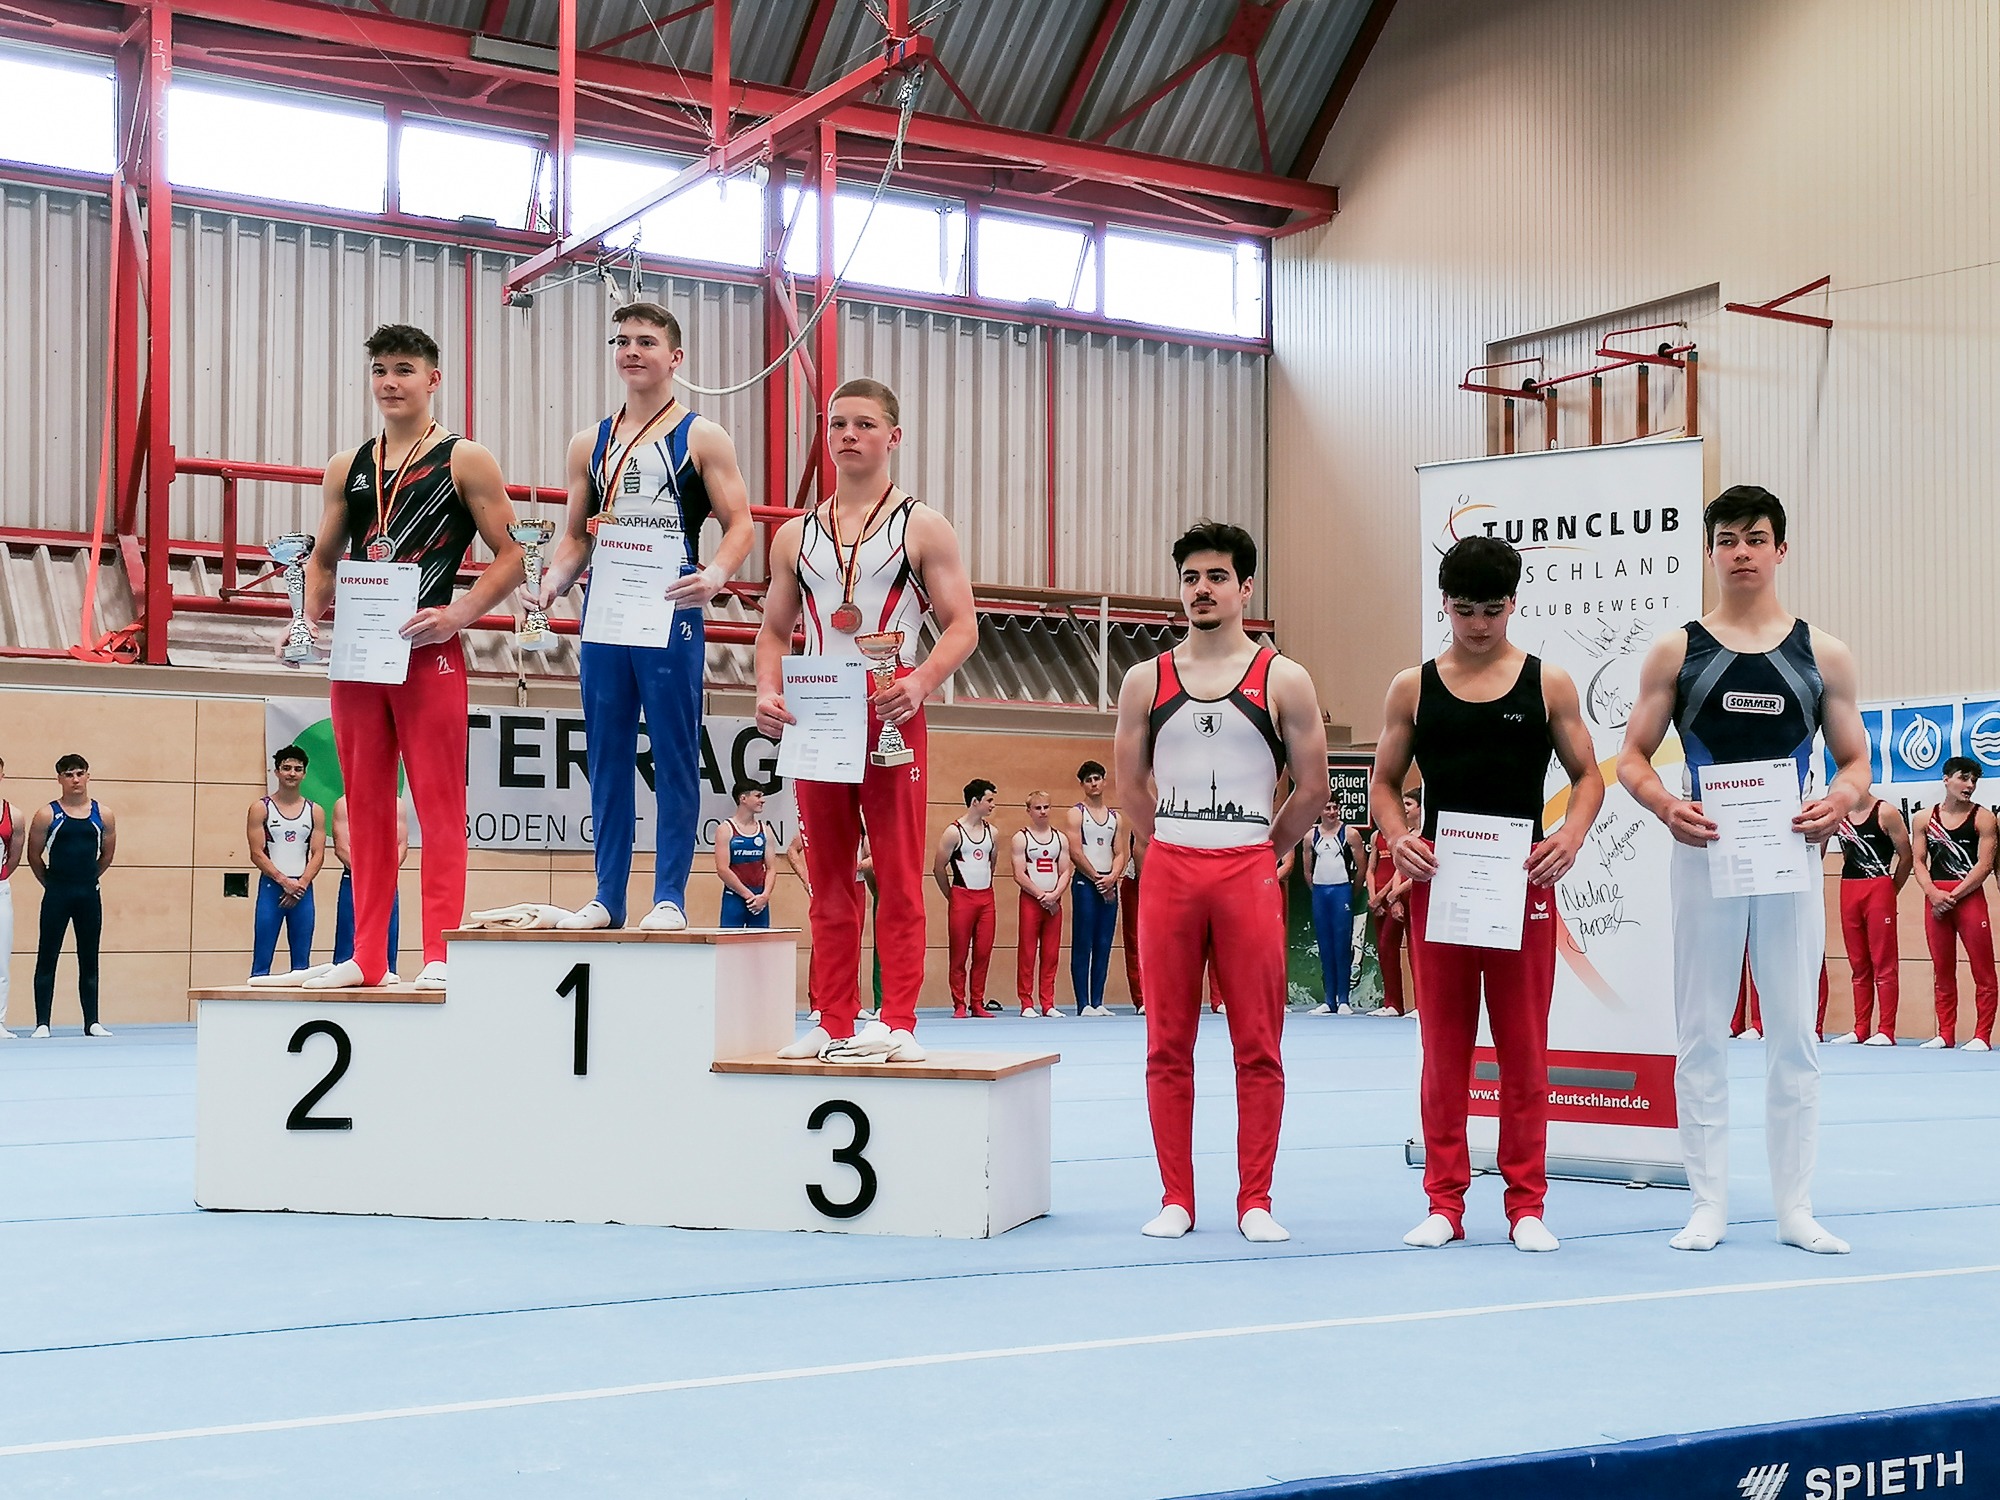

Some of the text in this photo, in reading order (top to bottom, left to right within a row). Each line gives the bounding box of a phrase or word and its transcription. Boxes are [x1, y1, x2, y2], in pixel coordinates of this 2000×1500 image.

[616, 517, 678, 529] SAPHARM
[1483, 507, 1679, 544] TURNCLUB
[601, 539, 653, 552] URKUNDE
[1526, 556, 1680, 584] SCHLAND
[340, 577, 389, 585] URKUNDE
[1520, 602, 1572, 618] CLUB
[787, 675, 838, 684] URKUNDE
[1730, 698, 1777, 709] SOMMER
[1330, 773, 1366, 791] gäuer
[1705, 778, 1765, 790] URKUNDE
[1441, 828, 1499, 841] URKUNDE
[556, 963, 590, 1075] 1
[286, 1020, 352, 1130] 2
[806, 1100, 877, 1218] 3
[1805, 1450, 1964, 1500] SPIETH
